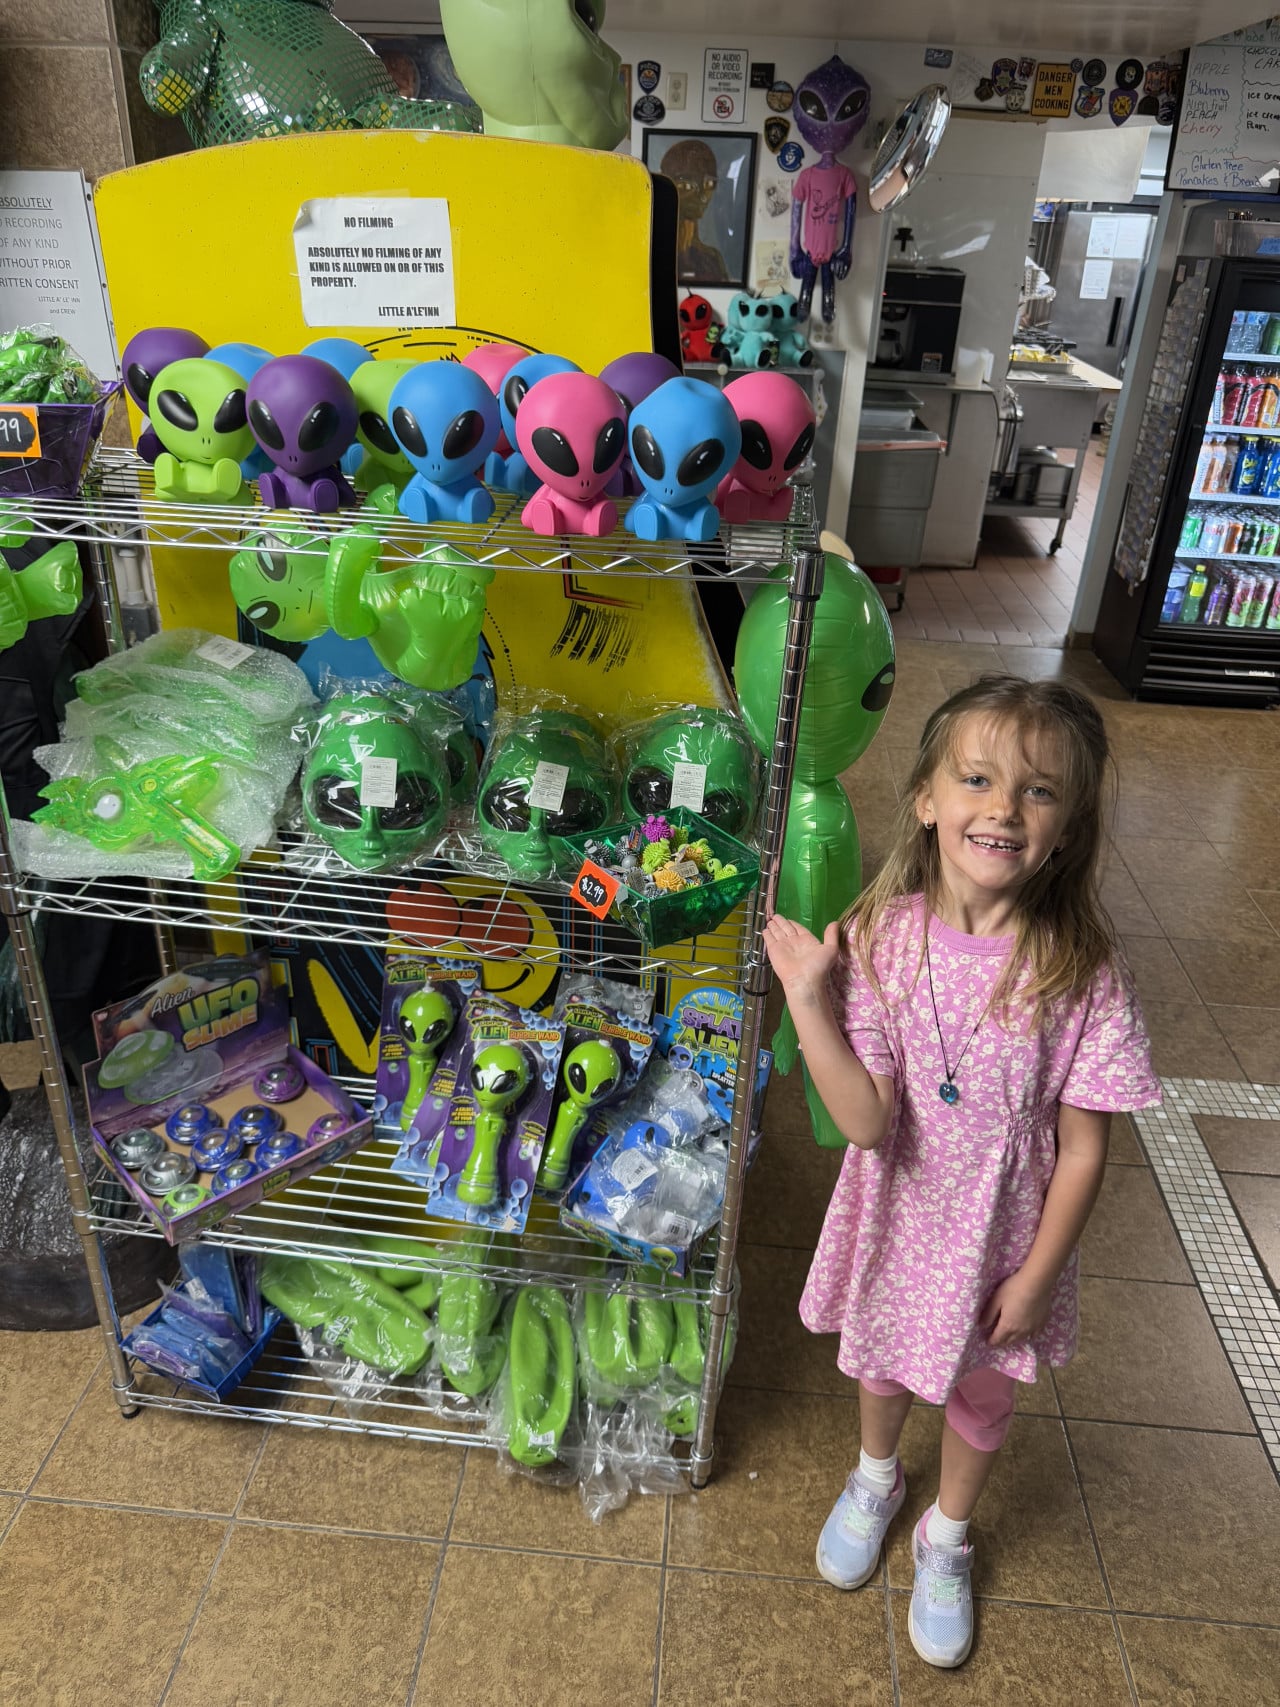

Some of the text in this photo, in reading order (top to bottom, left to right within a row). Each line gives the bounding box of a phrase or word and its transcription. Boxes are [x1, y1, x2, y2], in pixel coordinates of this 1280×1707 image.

[711, 53, 741, 62] NO AUDIO
[711, 62, 740, 71] OR VIDEO
[1192, 62, 1230, 75] APPLE
[708, 71, 742, 81] RECORDING
[1039, 71, 1073, 82] DANGER
[1044, 85, 1063, 96] MEN
[1034, 98, 1069, 110] COOKING
[1184, 110, 1218, 121] PEACH
[1191, 155, 1244, 173] Gluten Free
[1175, 168, 1218, 186] Pancakes
[5, 217, 62, 229] RECORDING
[344, 217, 394, 228] NO FILMING
[12, 238, 31, 249] ANY
[34, 238, 59, 250] KIND
[308, 247, 442, 258] ABSOLUTELY NO FILMING OF ANY
[42, 259, 72, 270] PRIOR
[309, 262, 445, 273] KIND IS ALLOWED ON OR OF THIS
[35, 278, 79, 290] CONSENT
[311, 276, 357, 288] PROPERTY.
[378, 306, 404, 316] LITTLE
[582, 876, 605, 903] $2.99
[389, 968, 426, 984] ALIEN
[454, 970, 477, 980] WAND
[151, 986, 196, 1019] Alien
[178, 977, 260, 1031] UFO
[182, 1003, 258, 1052] SLIME
[565, 1012, 601, 1031] ALIEN
[601, 1022, 628, 1038] BUBBLE
[628, 1030, 650, 1045] WAND
[682, 1007, 742, 1039] SPLAT
[471, 1026, 559, 1041] ALIEN BUBBLE WAND
[679, 1026, 740, 1059] ALIEN
